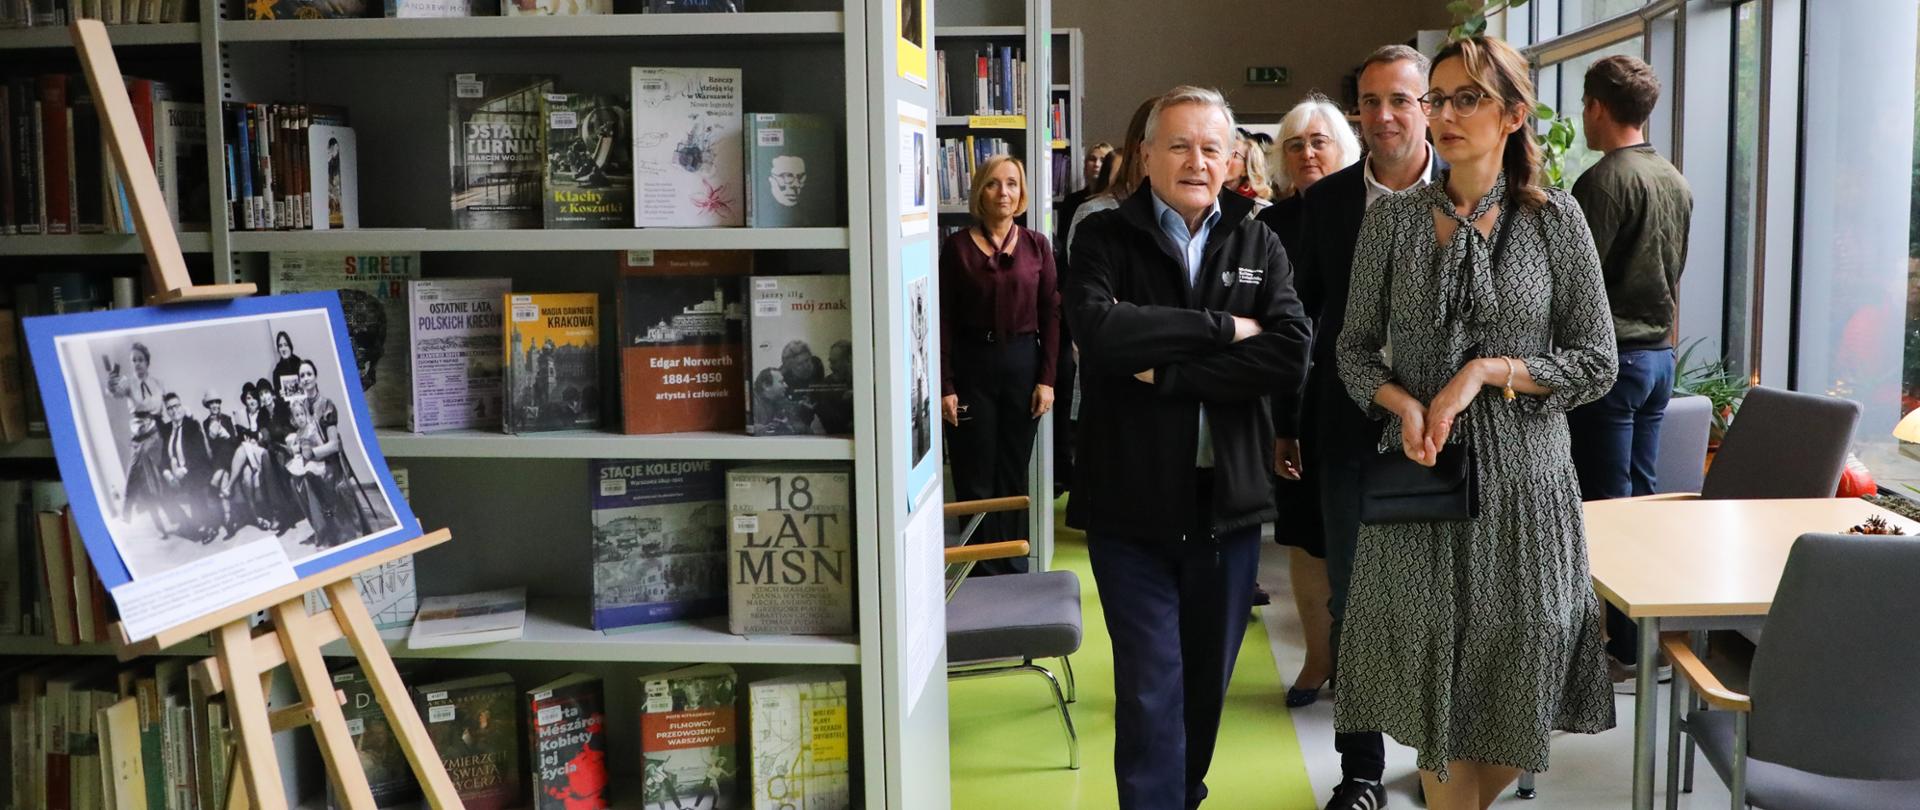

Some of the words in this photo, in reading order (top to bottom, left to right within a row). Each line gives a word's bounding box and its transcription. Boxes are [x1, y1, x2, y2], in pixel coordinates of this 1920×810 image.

[554, 191, 603, 204] Klachy
[345, 256, 411, 275] STREET
[429, 302, 468, 315] OSTATNIE
[471, 301, 493, 312] LATA
[791, 301, 815, 313] mój
[818, 299, 848, 311] znak
[418, 316, 464, 331] POLSKICH
[547, 315, 595, 328] KRAKOWA
[650, 357, 681, 370] Edgar
[683, 355, 733, 367] Norwerth
[655, 391, 686, 401] artysta
[600, 466, 643, 479] STACJE
[645, 461, 712, 475] KOLEJOWE
[767, 476, 813, 511] 18
[742, 513, 839, 548] LAT
[736, 550, 845, 584] MSN
[669, 720, 713, 730] FILMOWCY
[656, 727, 727, 739] PRZEDWOJENNEJ
[667, 735, 716, 746] WARSZAWY
[540, 731, 593, 752] Kobiety
[540, 751, 559, 769] jej
[542, 762, 578, 781] życia
[453, 775, 504, 796] YCERZY
